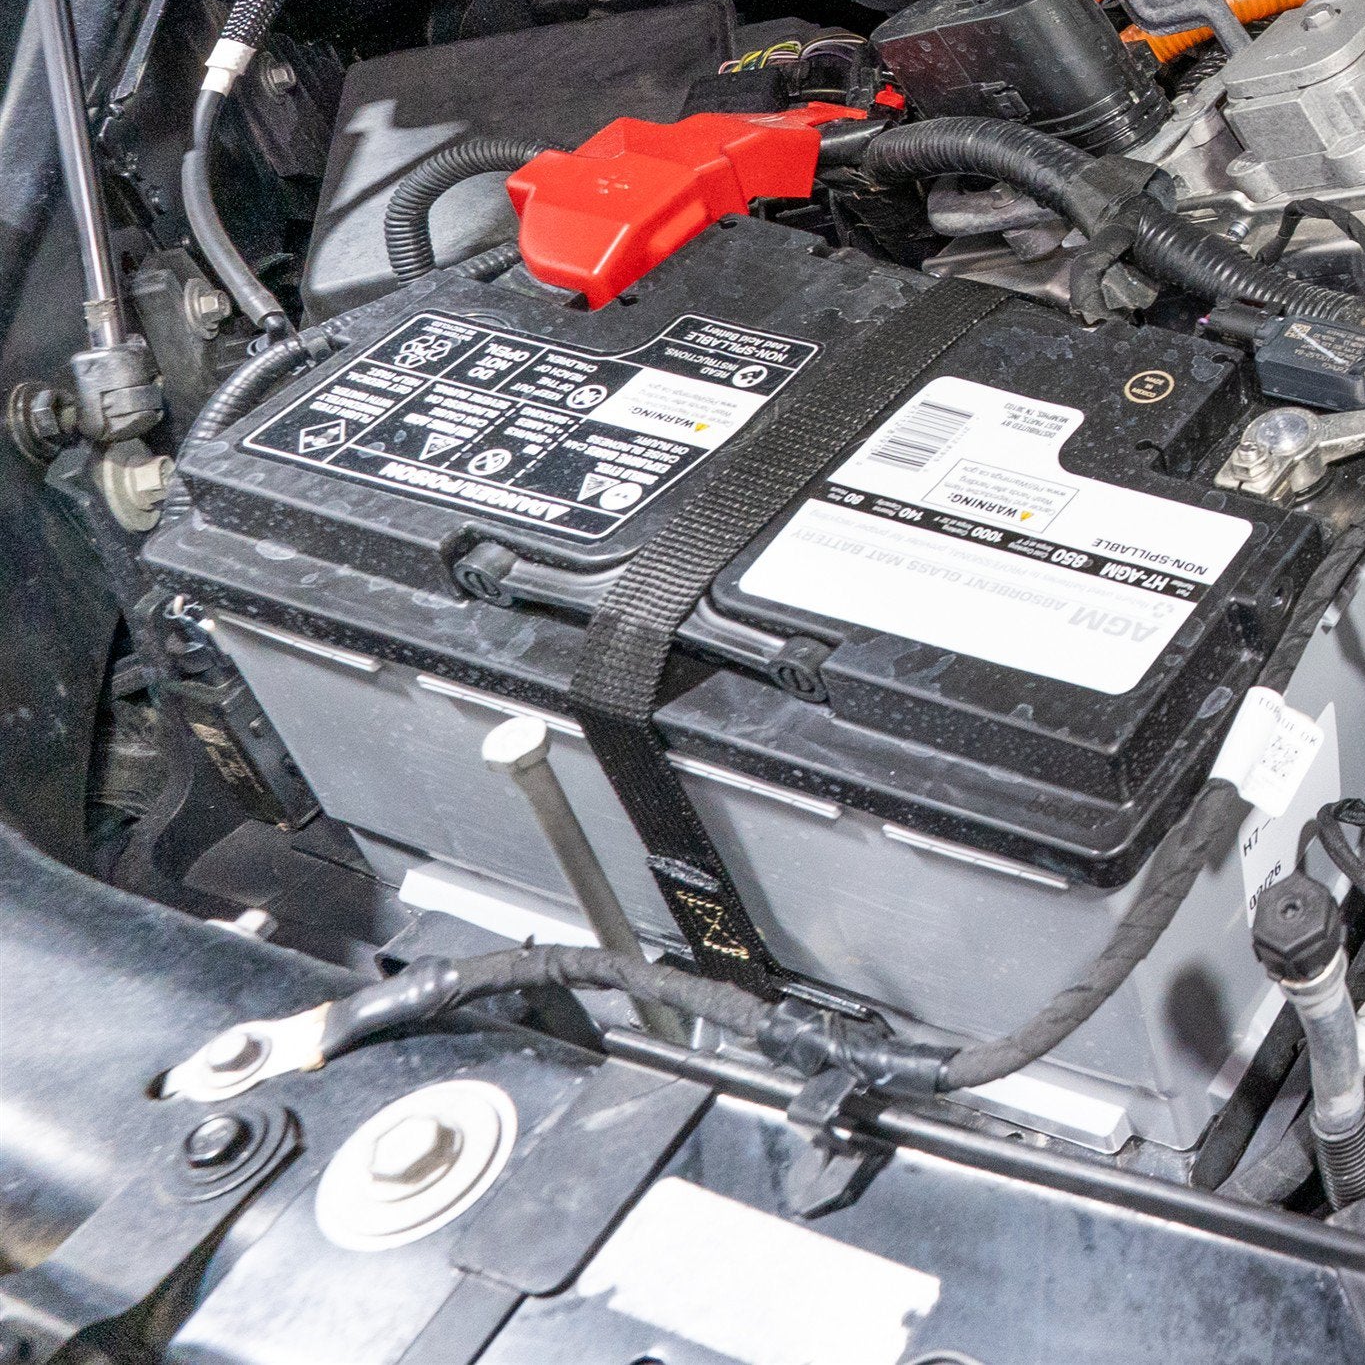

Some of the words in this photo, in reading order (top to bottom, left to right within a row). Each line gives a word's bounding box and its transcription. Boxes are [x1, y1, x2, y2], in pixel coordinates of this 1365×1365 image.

[700, 324, 742, 339] Battery
[736, 333, 765, 346] Acid
[481, 343, 532, 361] OPEN.
[683, 330, 788, 363] NON-SPILLABLE
[760, 339, 792, 353] Lead
[475, 355, 513, 370] NOT
[543, 354, 598, 372] CHILDREN.
[660, 346, 739, 371] INSTRUCTIONS.
[364, 366, 397, 379] FAST.
[464, 365, 497, 380] DO
[533, 363, 553, 373] OF
[547, 367, 588, 382] REACH
[698, 365, 731, 378] READ
[342, 372, 391, 388] MEDICAL
[390, 373, 424, 387] HELP
[509, 381, 536, 393] OUT
[535, 376, 561, 387] THE
[555, 381, 576, 391] OF
[385, 382, 415, 395] GET
[530, 387, 564, 401] KEEP
[422, 393, 445, 404] OR
[467, 393, 512, 409] SEVERE
[426, 406, 467, 422] CAUSE
[440, 398, 501, 418] BLINDNESS
[519, 406, 571, 424] SMOKING
[626, 405, 695, 427] WARNING:
[460, 415, 490, 428] CAN
[513, 417, 559, 433] FLAMES
[502, 426, 548, 442] SPARKS
[560, 439, 589, 451] CAN
[584, 434, 646, 454] BLINDNESS
[631, 435, 673, 450] INJURY.
[669, 444, 691, 455] OR
[641, 448, 682, 463] CAUSE
[377, 461, 552, 516] DANGER/POISON
[841, 491, 866, 505] 80
[945, 491, 1018, 517] WARNING:
[896, 506, 926, 522] 140
[790, 527, 865, 555] BATTERY
[970, 526, 1004, 542] 1000
[864, 548, 905, 566] MAT
[1048, 548, 1089, 568] 850
[1091, 537, 1207, 575] NON-SPILLABLE
[905, 559, 963, 582] GLASS
[1098, 561, 1170, 591] H7-AGM
[963, 575, 1067, 611] ABSORBENT
[1067, 605, 1160, 644] AGM
